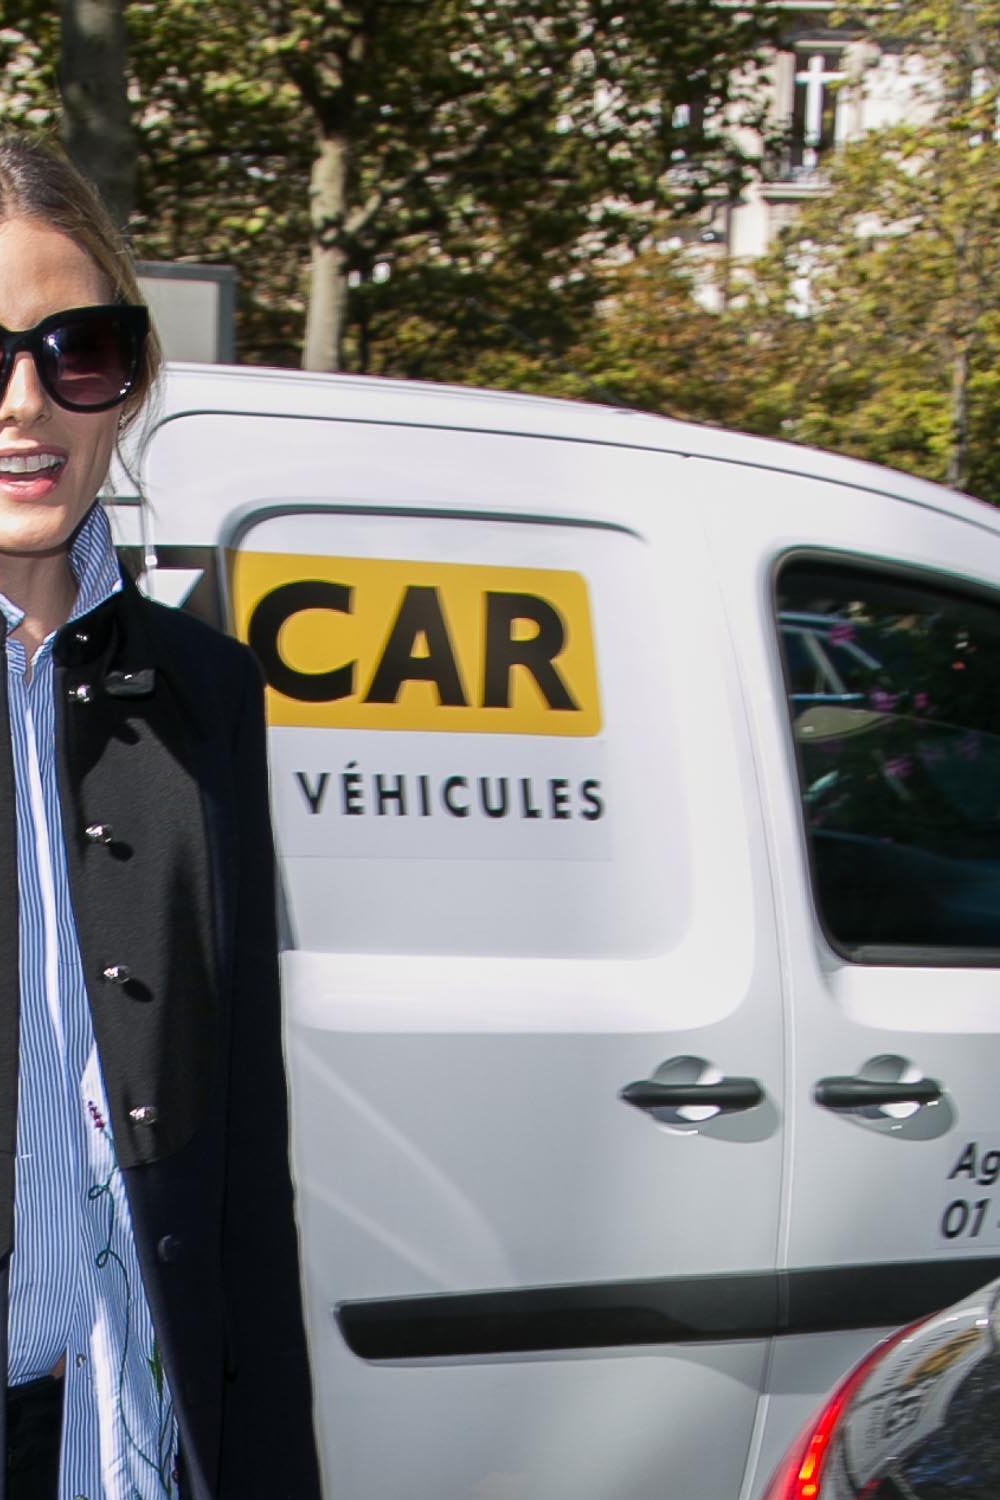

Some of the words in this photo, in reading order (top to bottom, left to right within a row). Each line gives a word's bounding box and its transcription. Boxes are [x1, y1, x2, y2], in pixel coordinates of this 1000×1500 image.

[247, 578, 583, 712] CAR
[294, 761, 606, 821] VÉHICULES
[941, 1198, 990, 1239] 01
